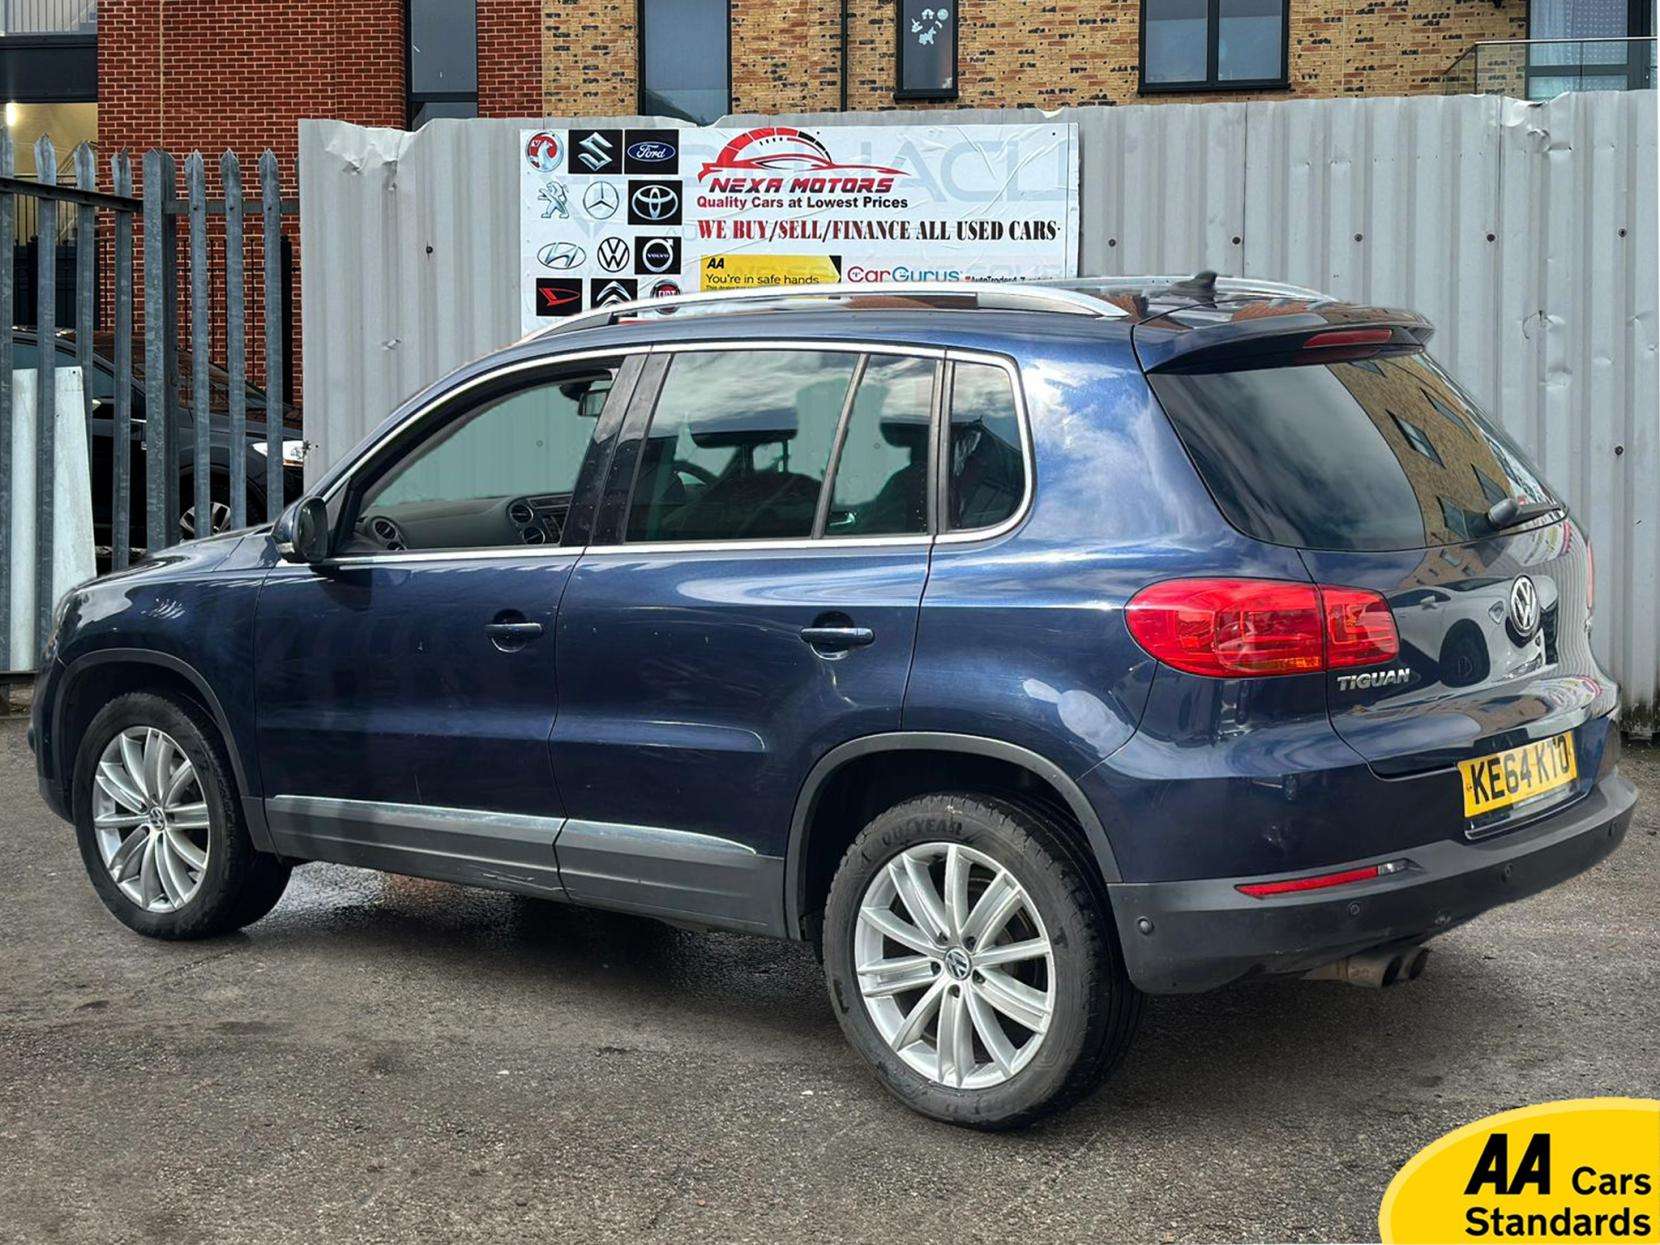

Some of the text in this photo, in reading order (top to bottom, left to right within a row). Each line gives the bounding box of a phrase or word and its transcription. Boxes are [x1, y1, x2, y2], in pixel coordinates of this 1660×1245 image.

[635, 144, 666, 158] Ford
[709, 178, 894, 193] NEXA MOTORS
[697, 196, 908, 208] Quality Cars at Lowest Prices
[697, 220, 727, 239] WE
[916, 221, 951, 240] ALL
[957, 220, 1004, 240] USED
[1009, 220, 1057, 240] CARS
[707, 258, 724, 269] AA
[706, 274, 819, 284] You're in safe hands
[847, 266, 960, 282] CarGurus
[1337, 668, 1410, 691] TIGUAN
[1470, 748, 1532, 805] KE64
